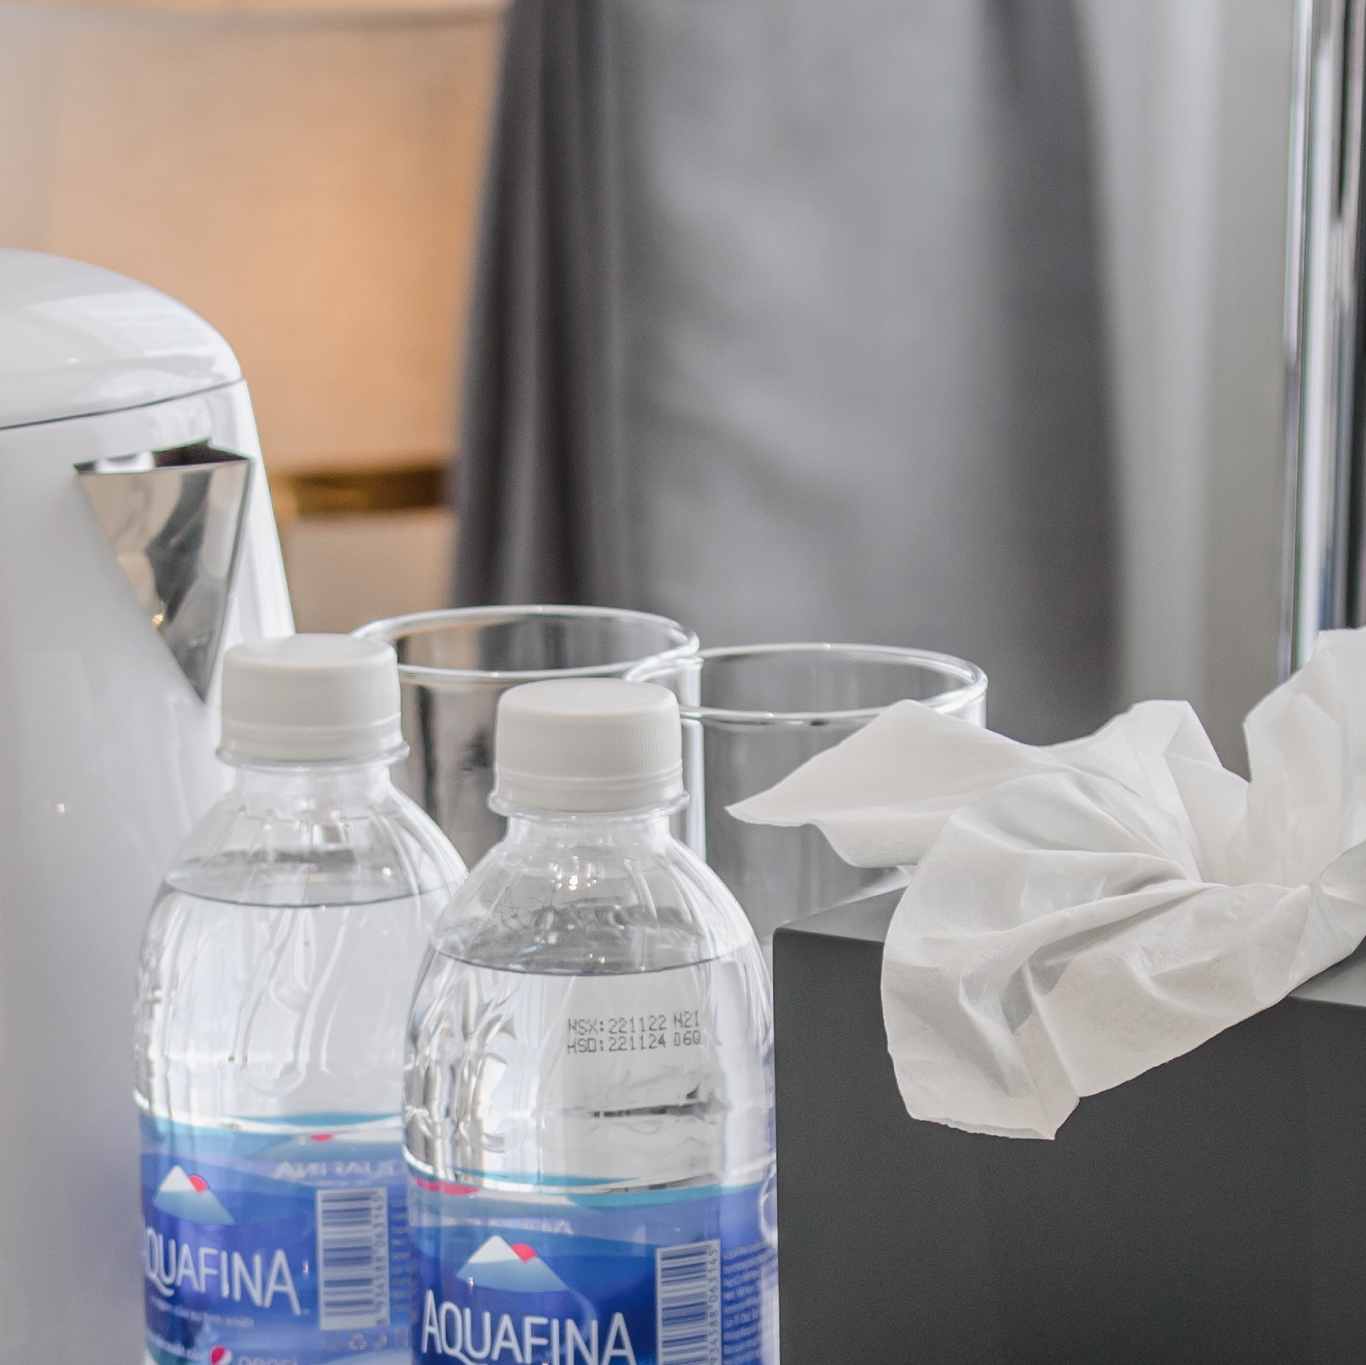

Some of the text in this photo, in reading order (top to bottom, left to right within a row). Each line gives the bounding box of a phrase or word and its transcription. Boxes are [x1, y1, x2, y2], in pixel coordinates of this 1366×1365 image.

[608, 1014, 667, 1035] 221122
[608, 1033, 667, 1052] 221124
[143, 1227, 302, 1316] QUAFINA
